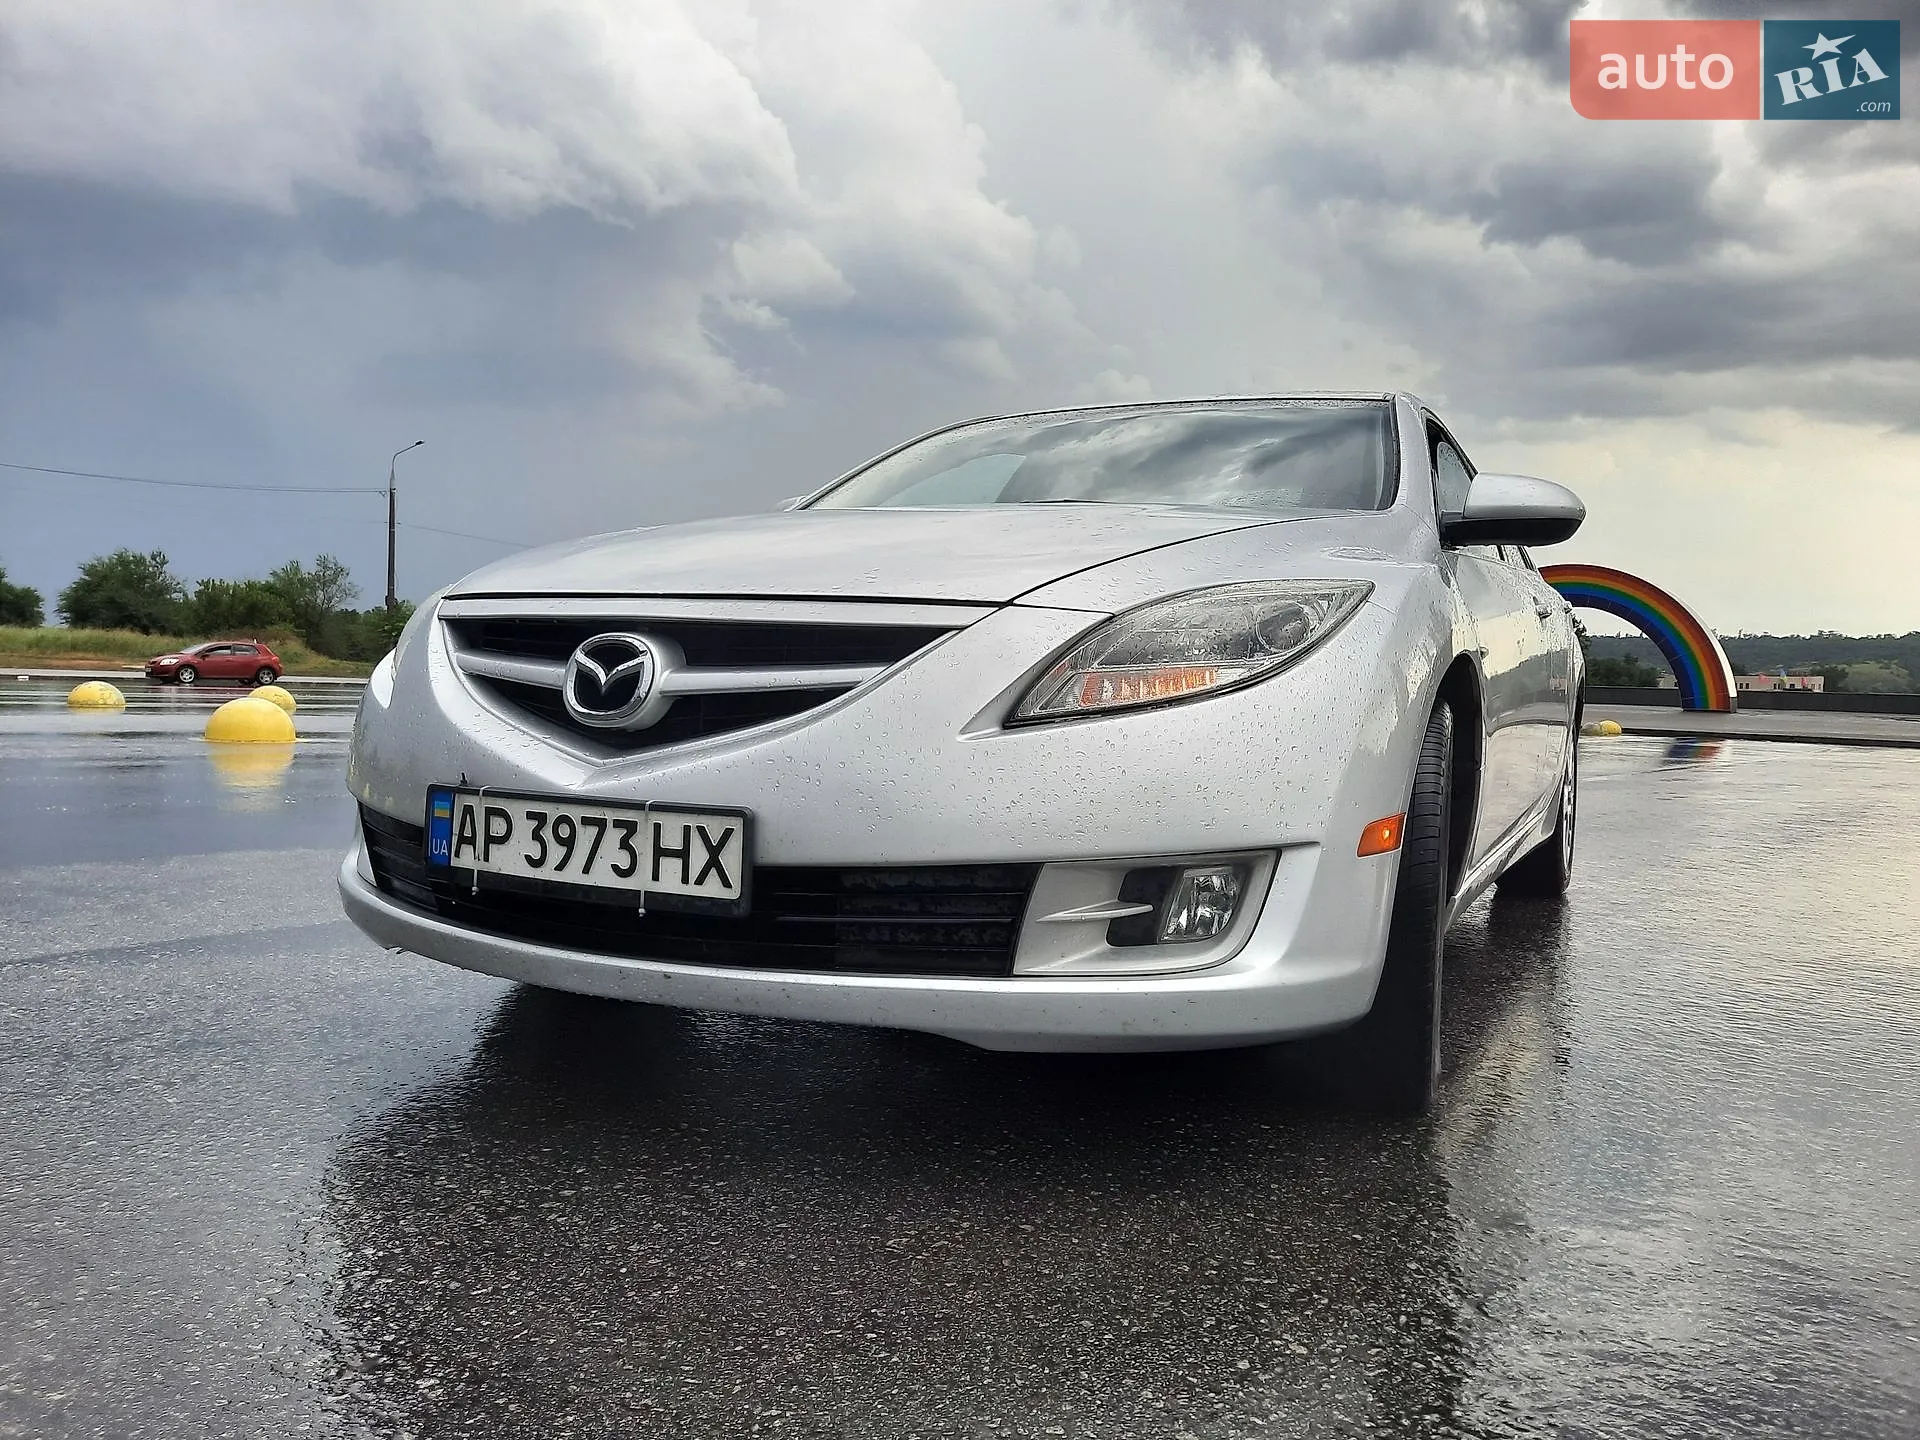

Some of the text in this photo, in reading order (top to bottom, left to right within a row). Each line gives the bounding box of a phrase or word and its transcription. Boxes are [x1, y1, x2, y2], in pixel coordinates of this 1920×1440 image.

[432, 838, 449, 856] UA
[454, 804, 735, 889] AP 3973 HX
